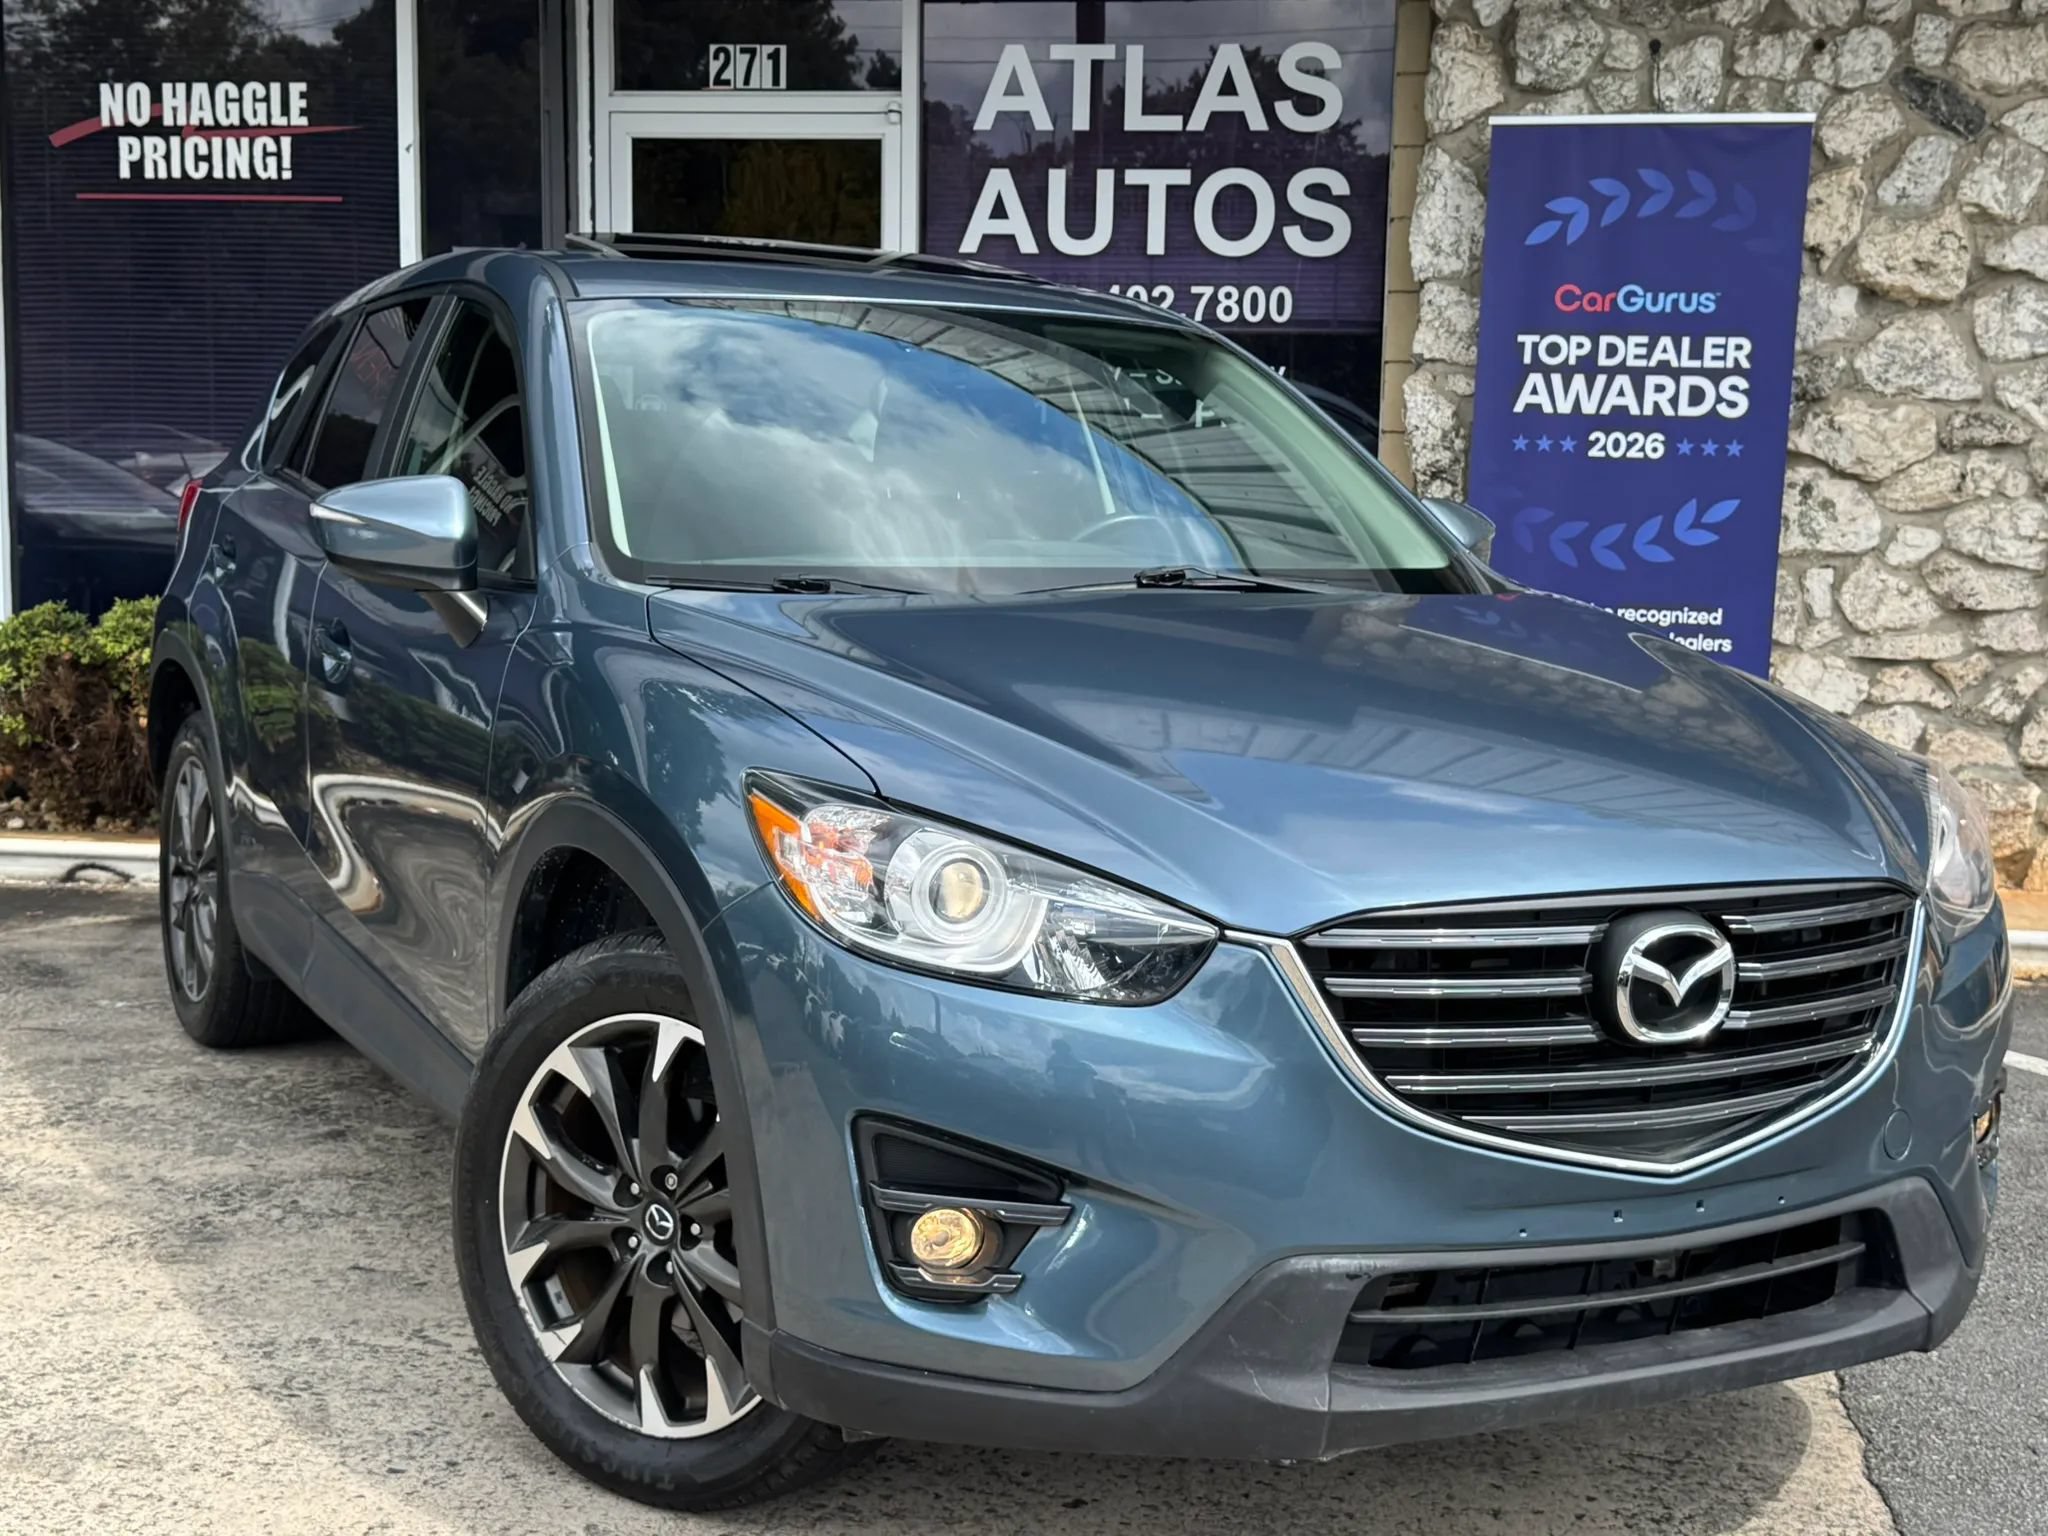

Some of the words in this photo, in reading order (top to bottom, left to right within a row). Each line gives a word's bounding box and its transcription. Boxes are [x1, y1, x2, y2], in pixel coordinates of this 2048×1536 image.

[712, 46, 781, 87] 271
[973, 42, 1344, 132] ATLAS
[100, 82, 151, 127] NO
[162, 81, 309, 127] HAGGLE
[118, 136, 292, 180] PRICING!
[958, 167, 1352, 257] AUTOS
[1109, 284, 1293, 323] 27800
[1555, 284, 1716, 313] CarGurus
[1517, 334, 1592, 366] TOP
[1598, 335, 1752, 369] DEALER
[1513, 372, 1750, 418] AWARDS
[1587, 431, 1666, 459] 2026
[1617, 607, 1723, 627] recognized
